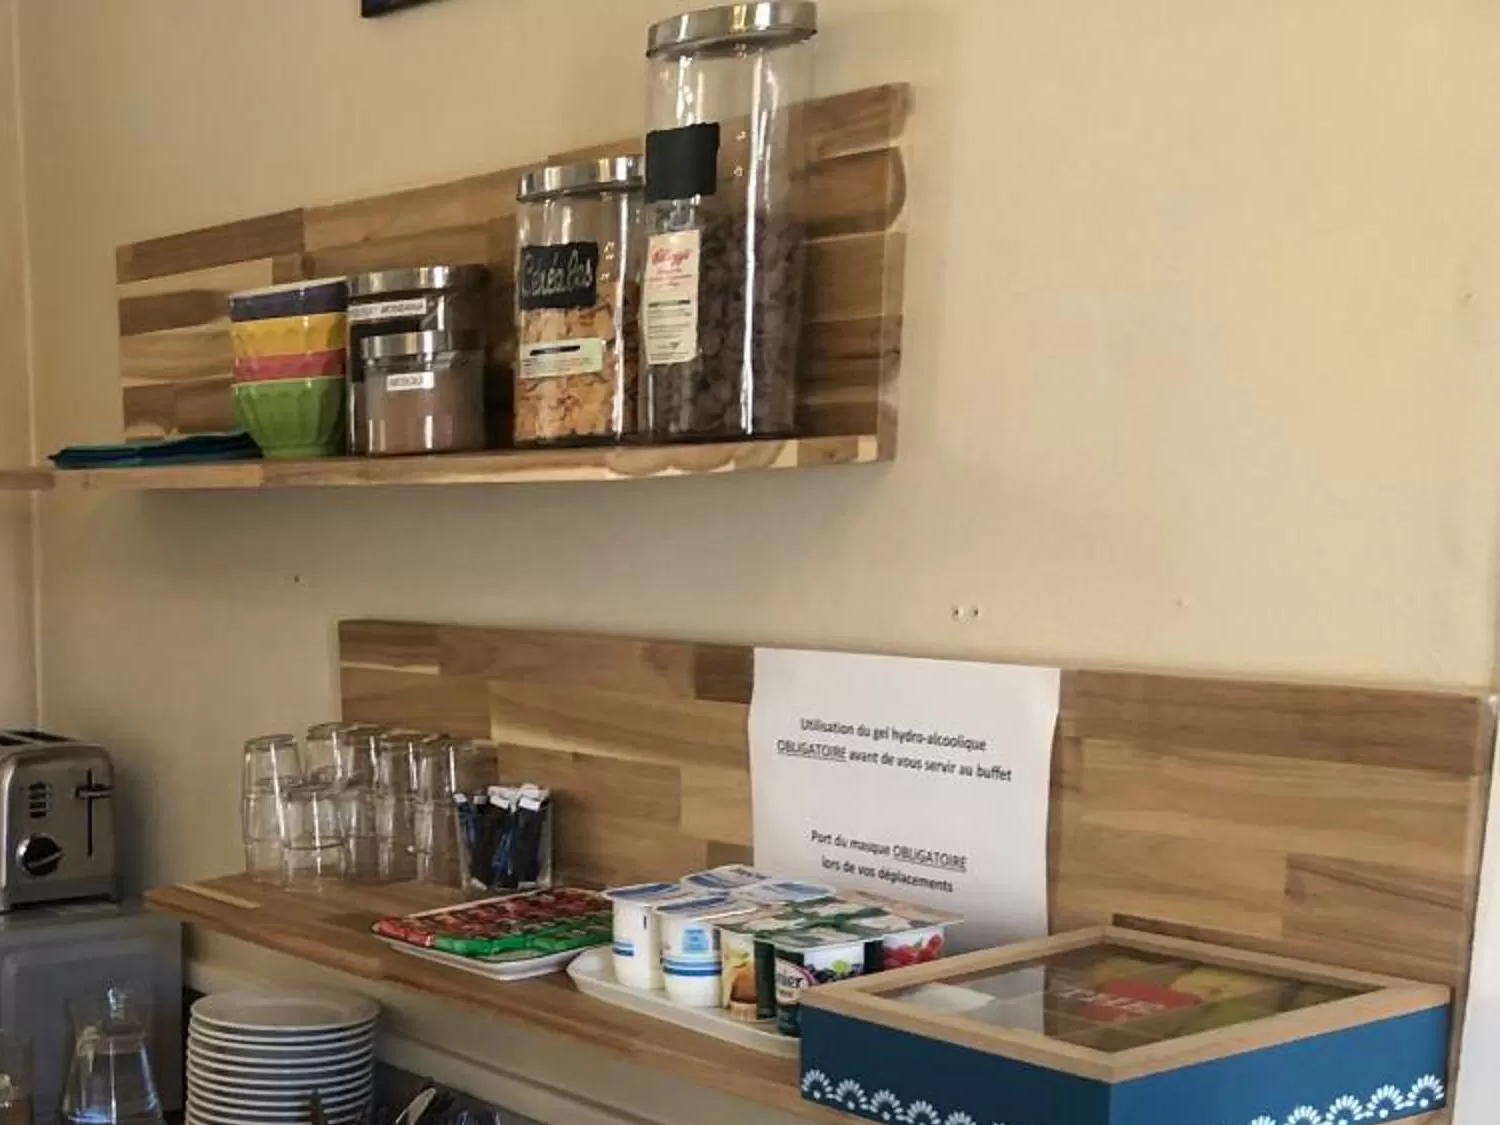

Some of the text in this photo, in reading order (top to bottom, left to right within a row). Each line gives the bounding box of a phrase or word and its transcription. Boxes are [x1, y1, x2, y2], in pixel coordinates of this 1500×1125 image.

[800, 717, 987, 752] Utilisation du gel hydro-alcoolique
[776, 739, 1013, 783] OBLIGATOIRE avant de vous servir au buffet
[811, 829, 968, 872] Port du masque OBLIGATOIRE
[821, 855, 841, 872] lors
[843, 859, 857, 875] de
[858, 864, 876, 878] vos
